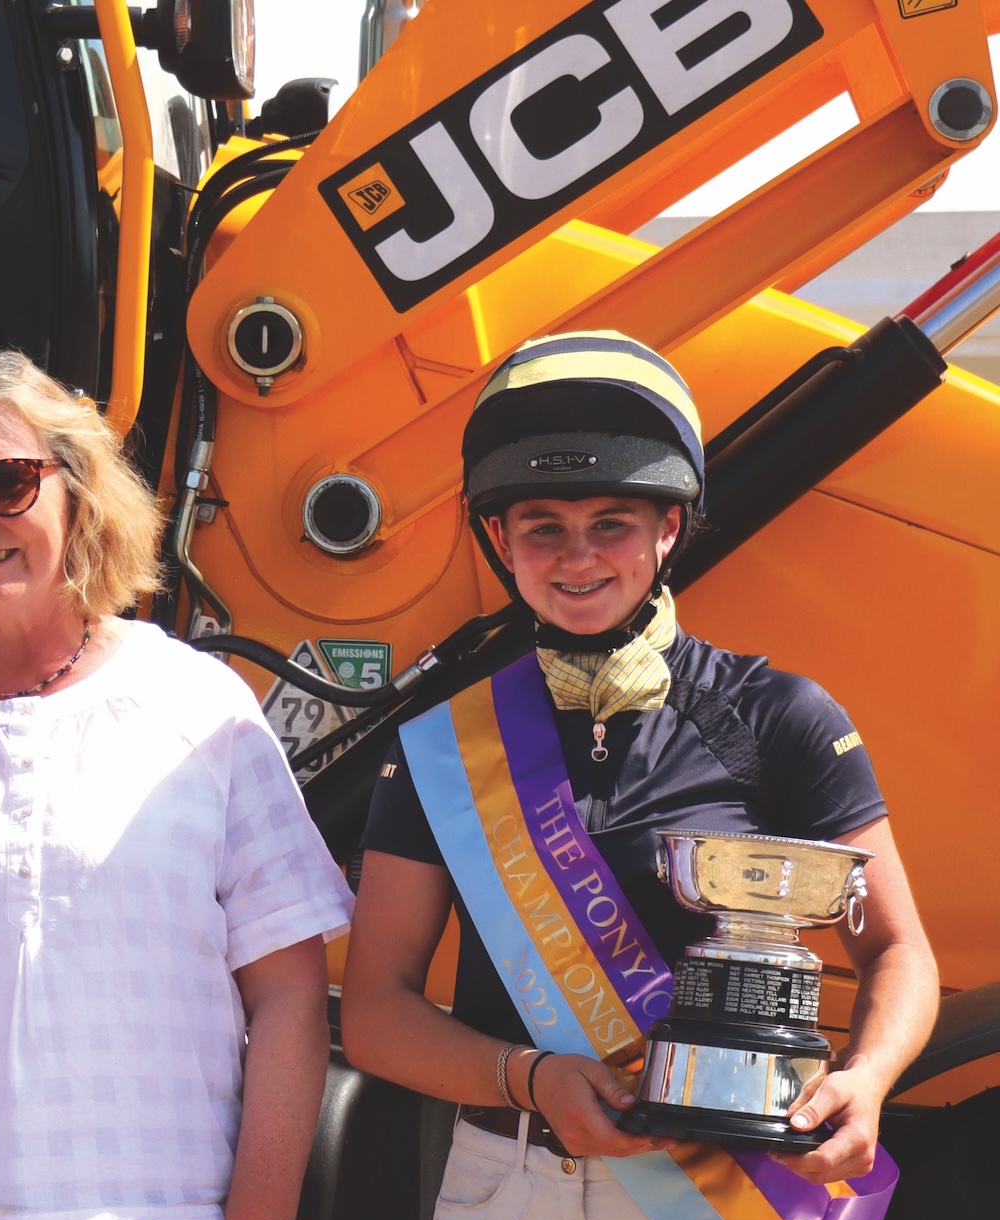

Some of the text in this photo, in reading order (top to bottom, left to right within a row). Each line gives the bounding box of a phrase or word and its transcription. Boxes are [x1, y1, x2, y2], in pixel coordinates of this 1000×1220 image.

[374, 0, 793, 281] JCB
[355, 183, 388, 211] JCB
[332, 648, 384, 659] EMISSIONS
[359, 663, 382, 689] 5
[282, 697, 325, 733] 79
[534, 789, 586, 871] THE
[570, 869, 656, 980] PONY
[503, 948, 558, 1036] 2022
